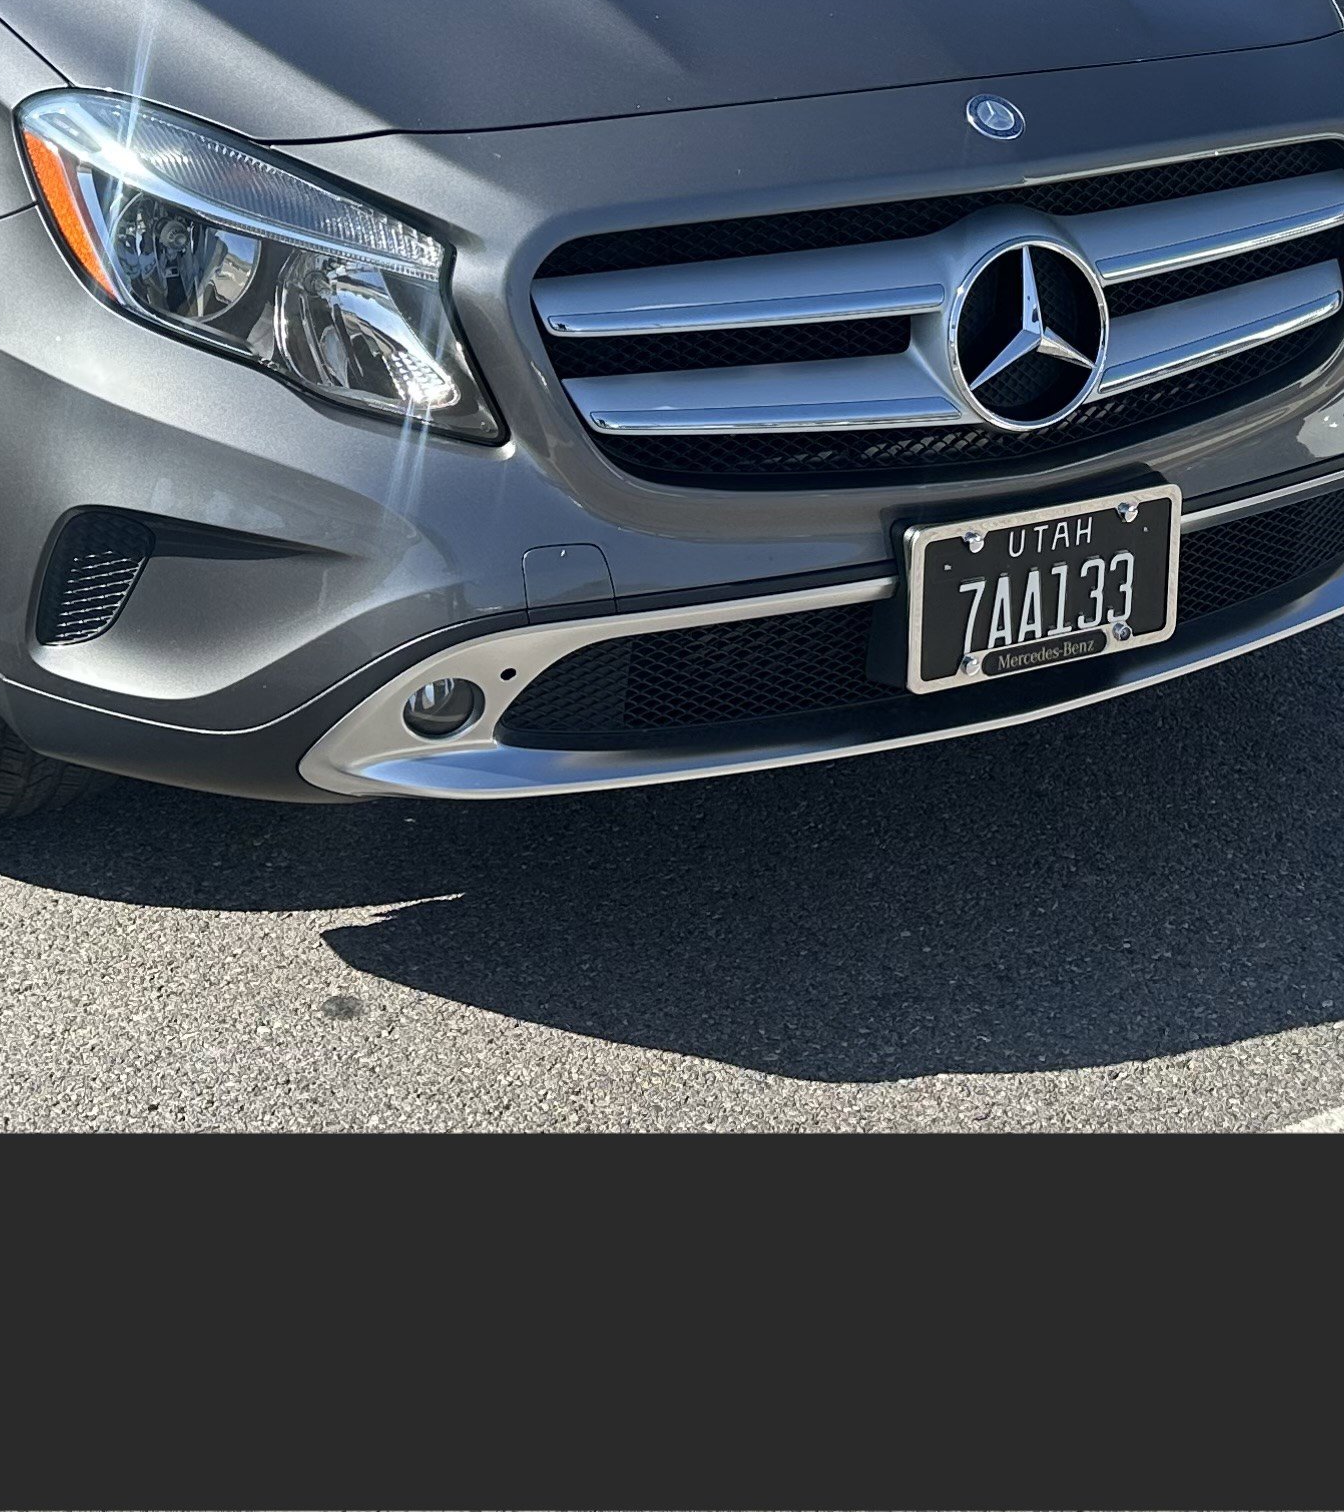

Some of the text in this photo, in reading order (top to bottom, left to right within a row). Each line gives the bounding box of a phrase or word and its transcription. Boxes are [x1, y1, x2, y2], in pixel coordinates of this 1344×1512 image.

[1008, 516, 1093, 558] UTAH
[958, 551, 1135, 655] 7AA133
[997, 638, 1095, 671] Mercedes-Benz
